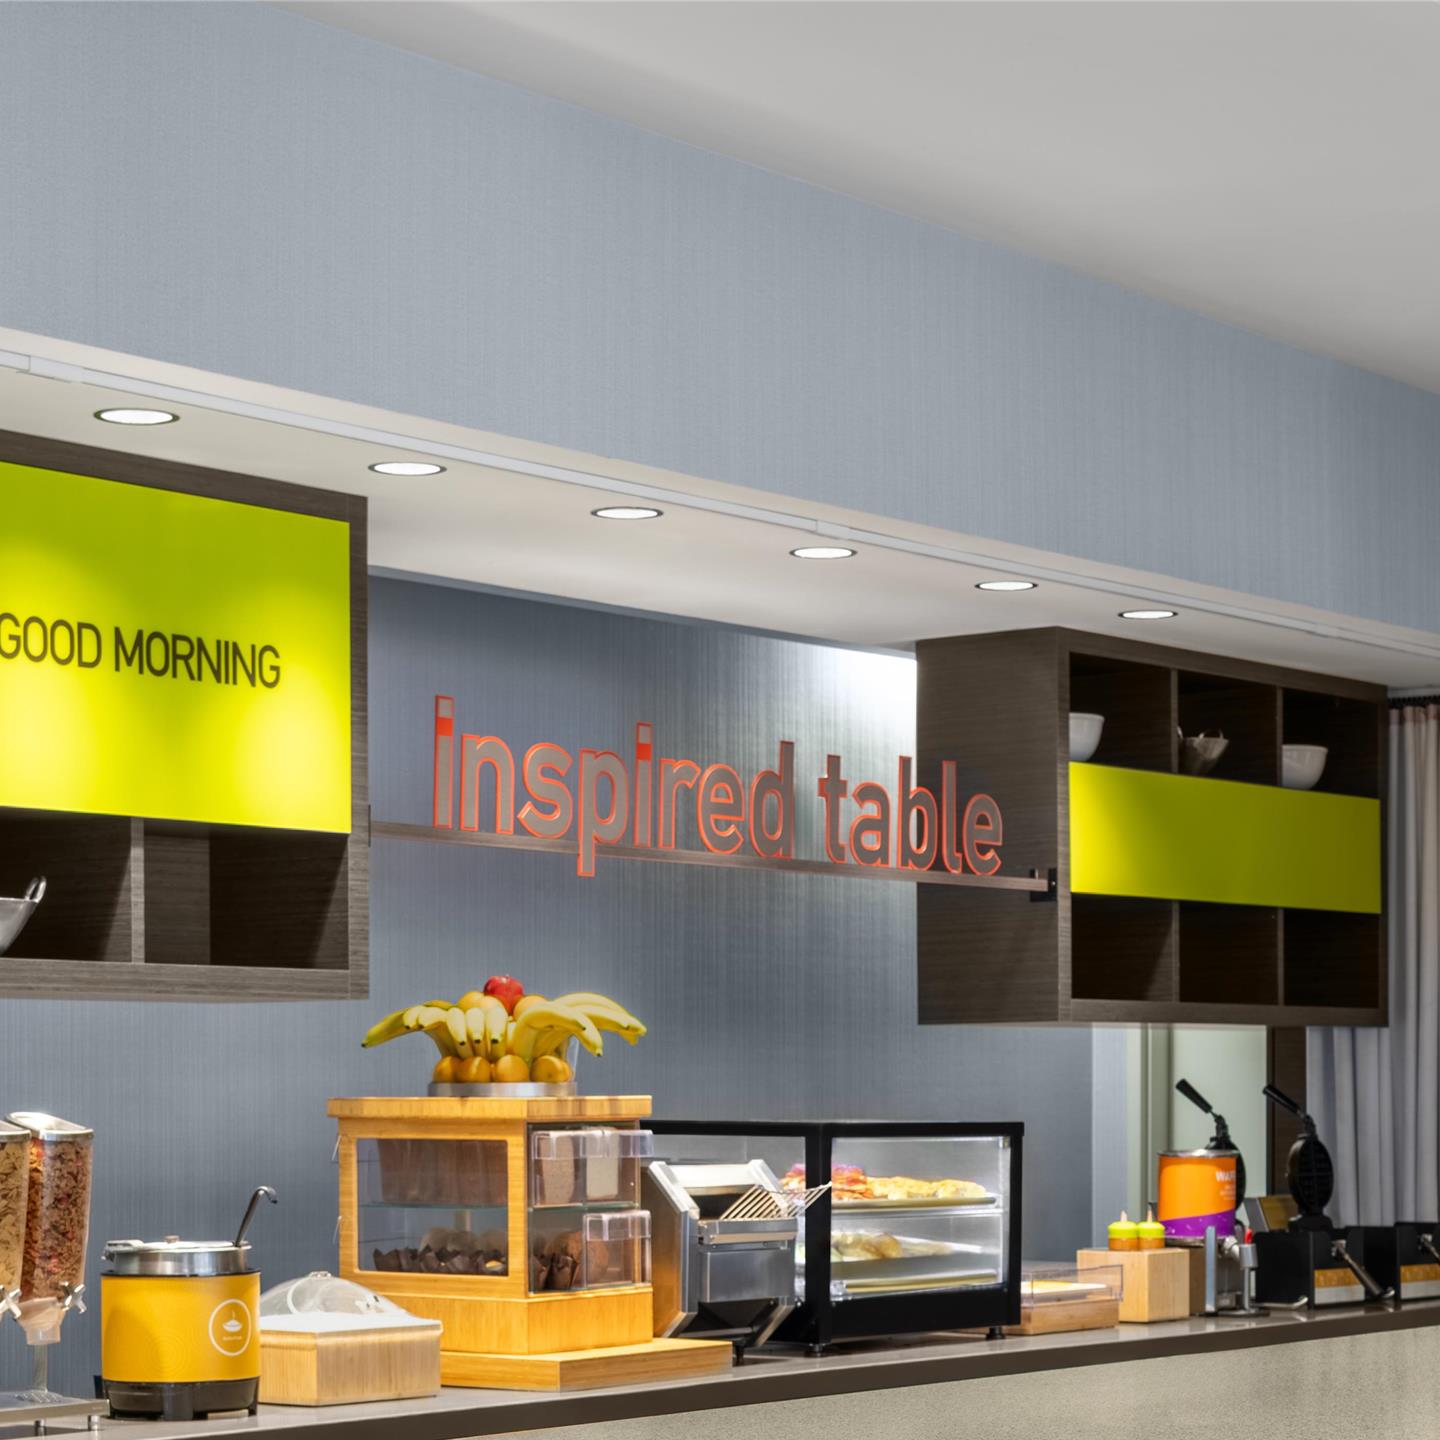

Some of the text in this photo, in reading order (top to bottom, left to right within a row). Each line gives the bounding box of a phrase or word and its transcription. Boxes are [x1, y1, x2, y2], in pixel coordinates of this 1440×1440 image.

[114, 626, 281, 689] MORNING
[433, 694, 1003, 877] inspired table
